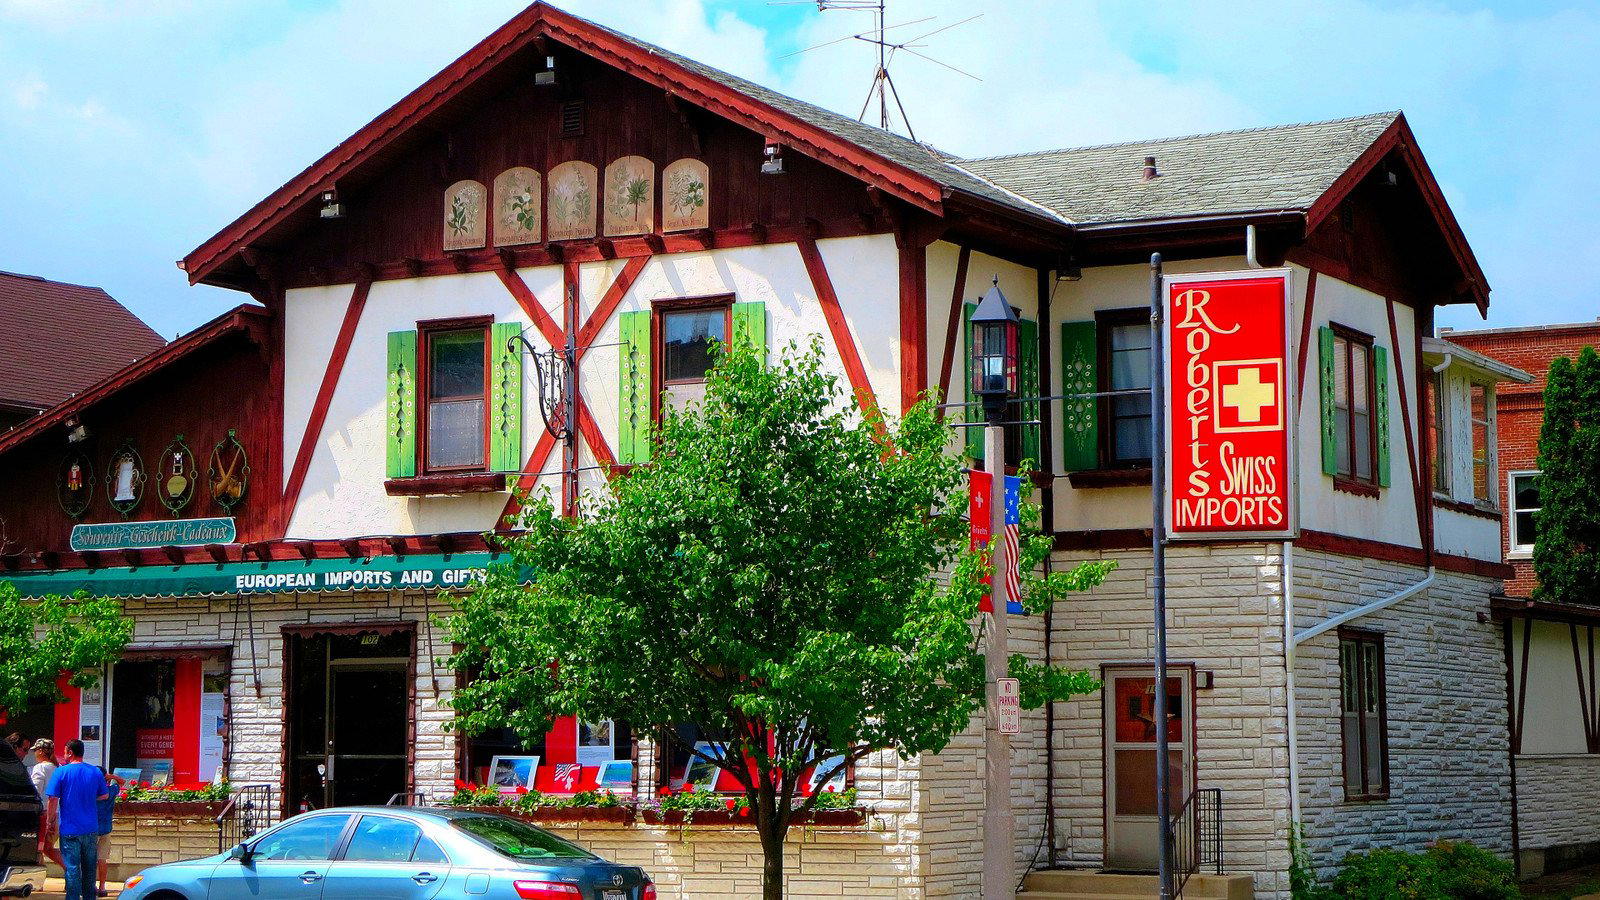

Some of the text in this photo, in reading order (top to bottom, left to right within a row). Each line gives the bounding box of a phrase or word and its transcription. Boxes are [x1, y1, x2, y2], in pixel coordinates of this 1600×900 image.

[1175, 289, 1241, 497] Roberts
[1175, 496, 1283, 527] IMPORTS
[236, 573, 315, 588] EUROPEAN
[325, 571, 392, 585] IMPORTS
[401, 569, 433, 584] AND
[999, 696, 1018, 706] PARKING
